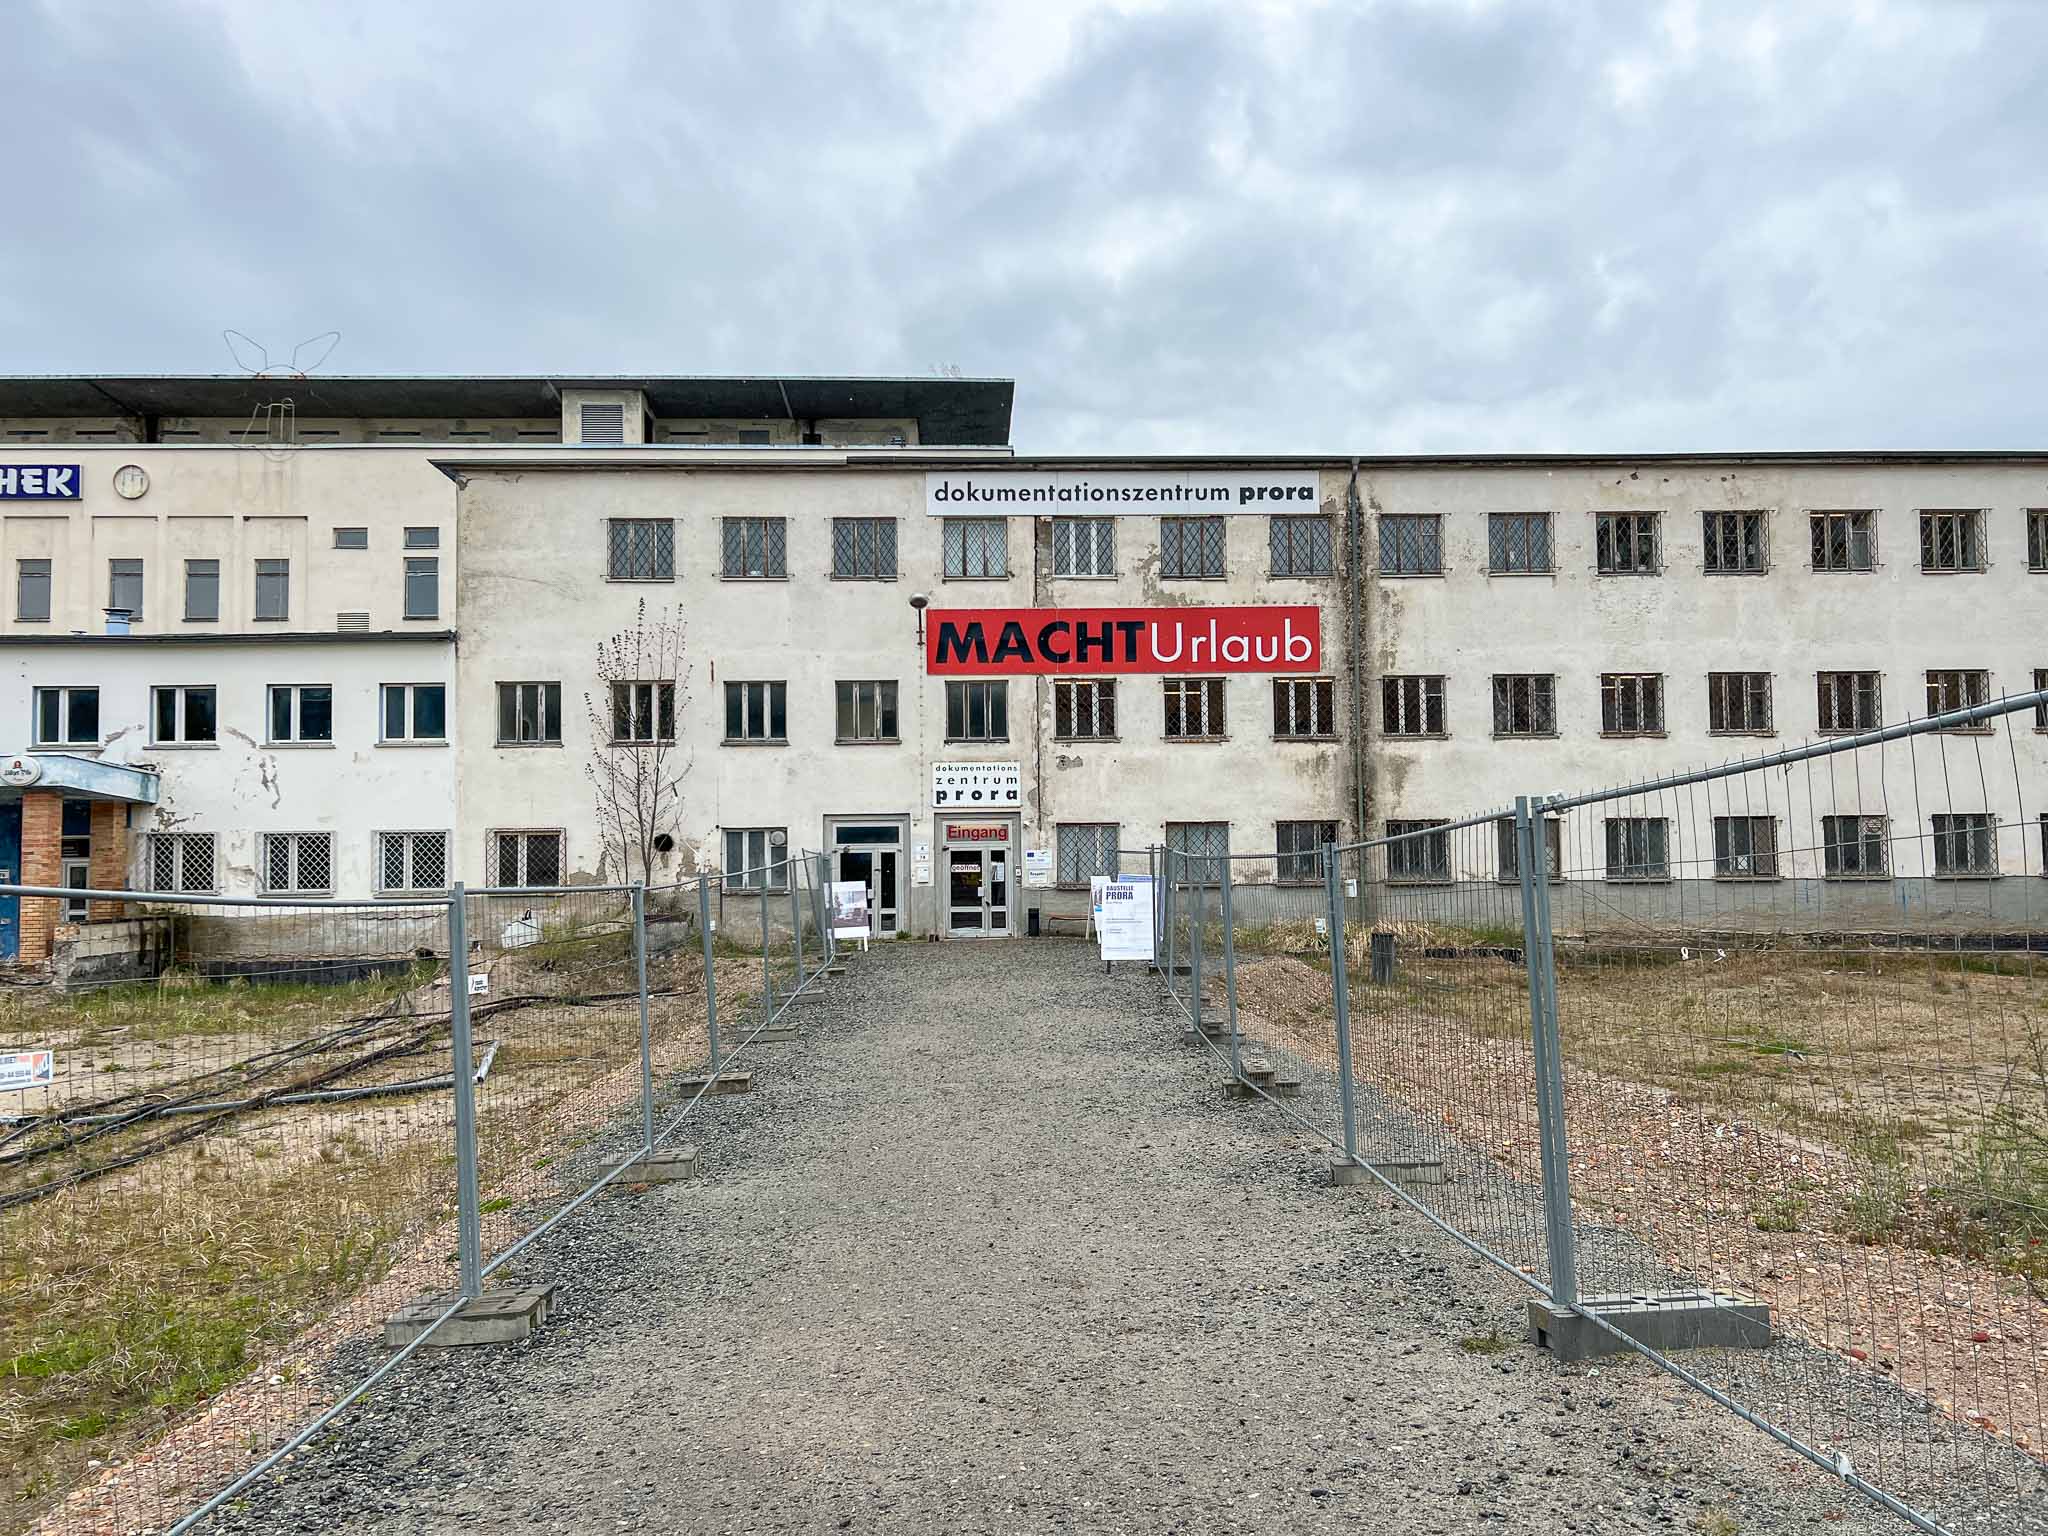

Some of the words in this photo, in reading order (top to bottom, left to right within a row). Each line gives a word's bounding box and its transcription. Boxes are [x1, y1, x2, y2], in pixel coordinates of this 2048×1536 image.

[934, 480, 1230, 502] dokumentationszentrum
[1239, 486, 1313, 505] prora
[936, 776, 1017, 784] zentrum
[936, 790, 1018, 804] prora
[948, 826, 1008, 841] Eingang
[1106, 892, 1134, 900] PRORA
